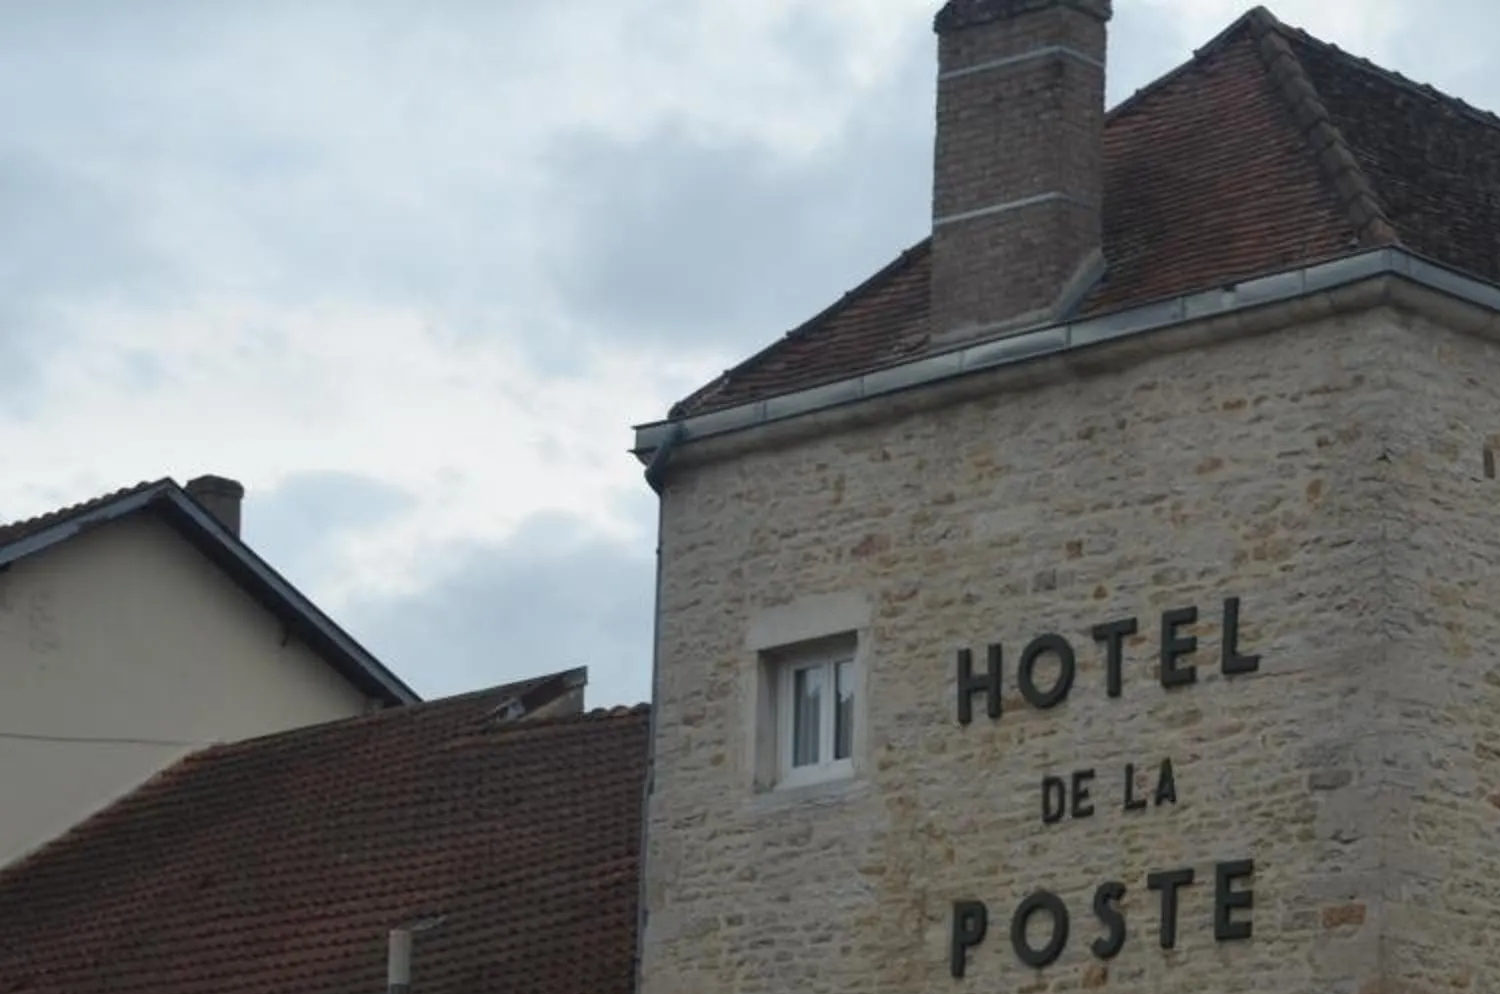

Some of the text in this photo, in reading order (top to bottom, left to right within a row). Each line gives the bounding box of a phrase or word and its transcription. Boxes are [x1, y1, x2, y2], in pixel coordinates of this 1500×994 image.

[957, 597, 1261, 726] HOTEL
[1042, 758, 1177, 824] DE LA
[950, 859, 1254, 979] POSTE
